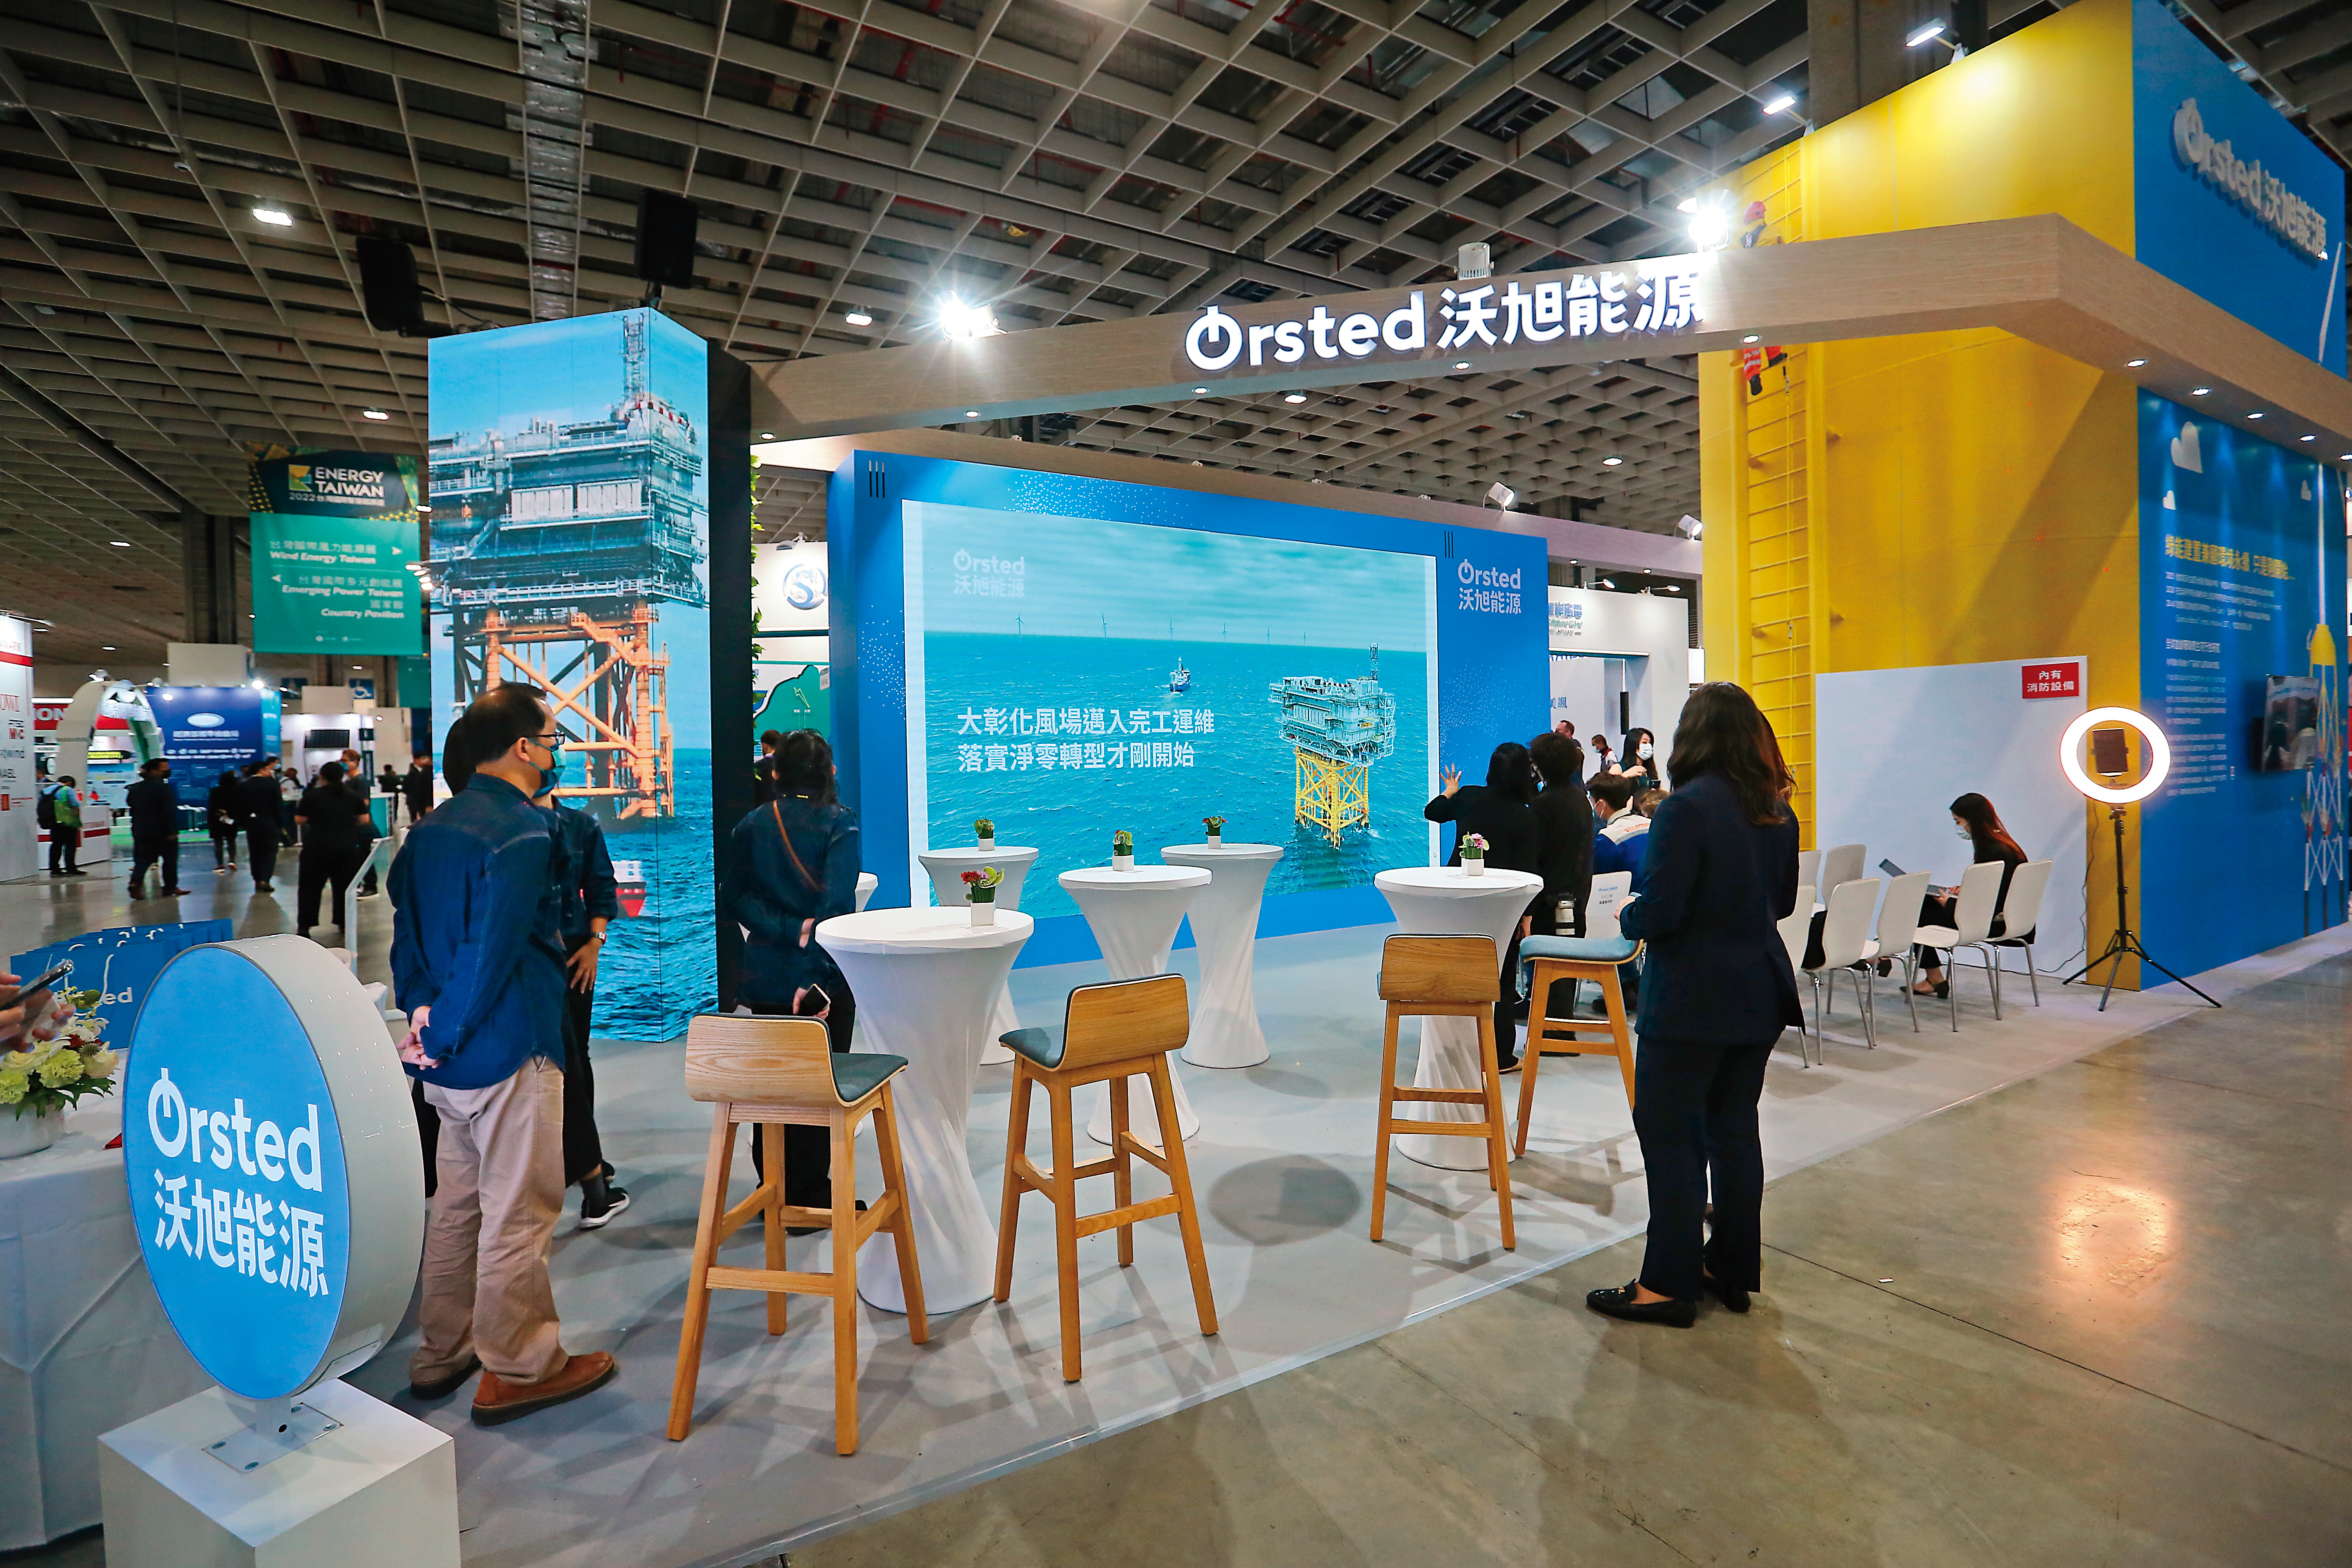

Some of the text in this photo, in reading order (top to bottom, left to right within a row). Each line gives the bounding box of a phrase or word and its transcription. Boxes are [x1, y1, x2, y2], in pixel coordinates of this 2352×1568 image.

[1436, 270, 1707, 350] 沃旭能源
[315, 467, 384, 484] ENERGY
[315, 480, 385, 498] TAIWAN
[270, 551, 299, 560] Wind
[300, 552, 337, 564] Energy
[954, 574, 1025, 597] 沃旭能源
[1458, 588, 1521, 614] 沃旭能源
[2027, 681, 2074, 692] 消防設備
[958, 707, 1214, 735] 大彰化風場邁入完工運維
[958, 742, 1194, 772] 落實淨零轉型才剛開始
[154, 1169, 329, 1297] 沃旭能源
